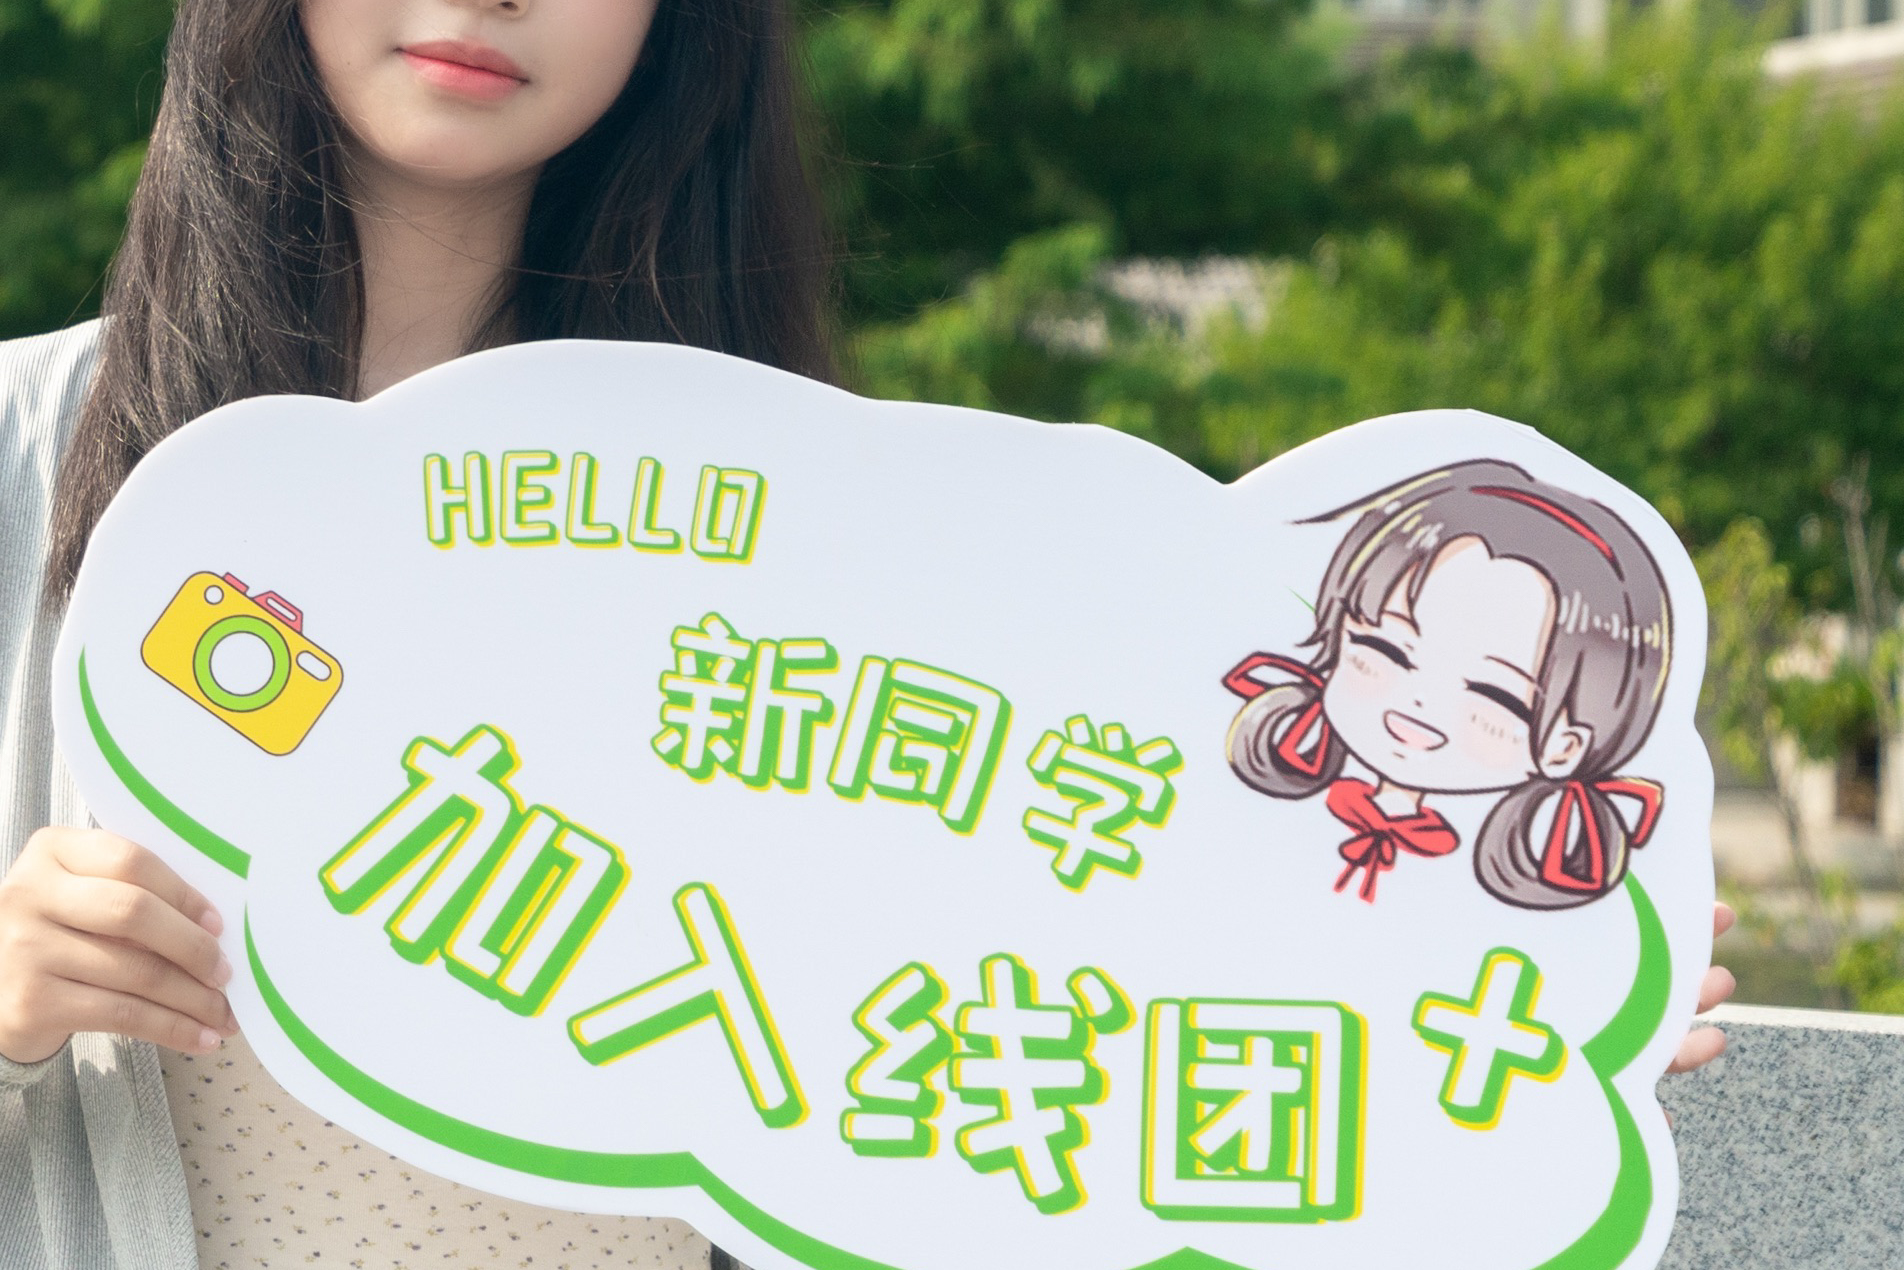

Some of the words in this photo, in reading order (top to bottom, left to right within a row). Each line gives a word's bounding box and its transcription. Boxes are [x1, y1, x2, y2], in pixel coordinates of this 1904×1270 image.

[422, 450, 767, 564] HELLO
[653, 612, 1185, 890] 新同学
